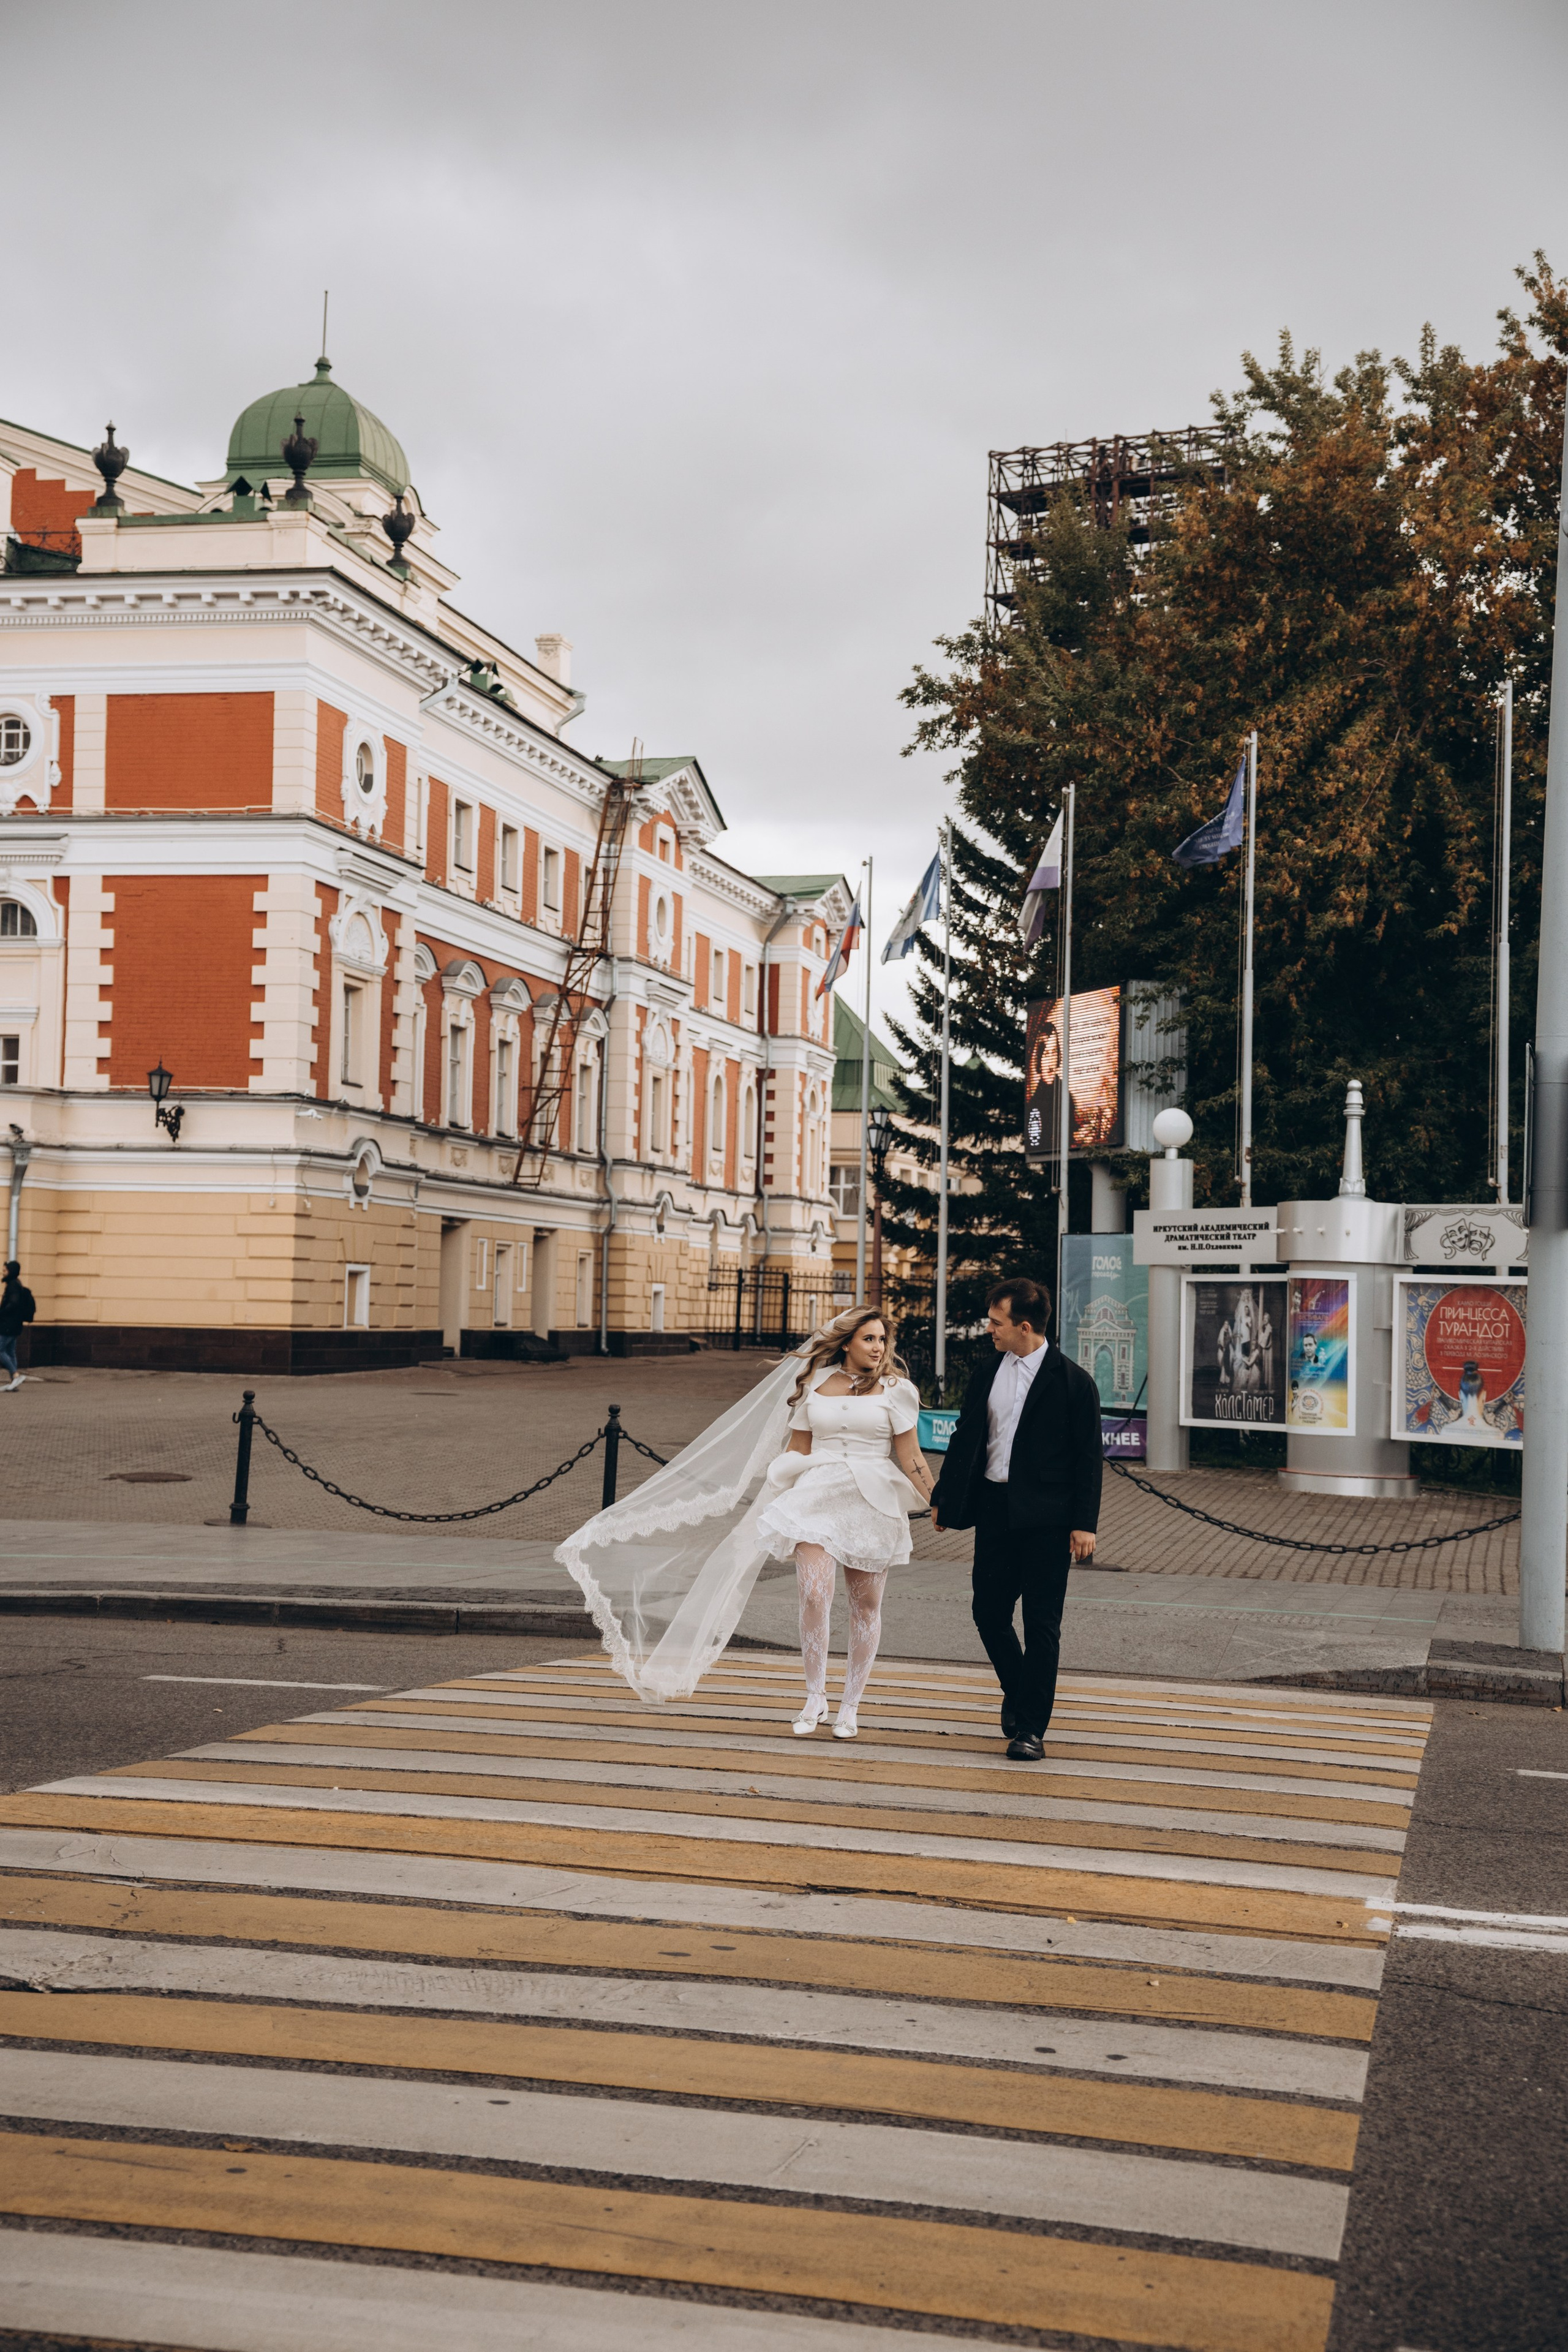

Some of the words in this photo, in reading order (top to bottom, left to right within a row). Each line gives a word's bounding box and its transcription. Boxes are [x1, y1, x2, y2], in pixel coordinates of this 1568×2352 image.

[1153, 1224, 1198, 1232] ИРКУТСКИЙ
[1200, 1222, 1270, 1232] АКАДЕМИЧЕСКИЙ
[1164, 1232, 1231, 1242] ДРАМАТИЧЕСКИЙ
[1092, 1256, 1122, 1270] ГОЛОС
[1440, 1306, 1509, 1321] ПРИНЦЕССА
[1438, 1321, 1510, 1338] ТУРАНДОТ
[932, 1419, 957, 1436] ГОЛО
